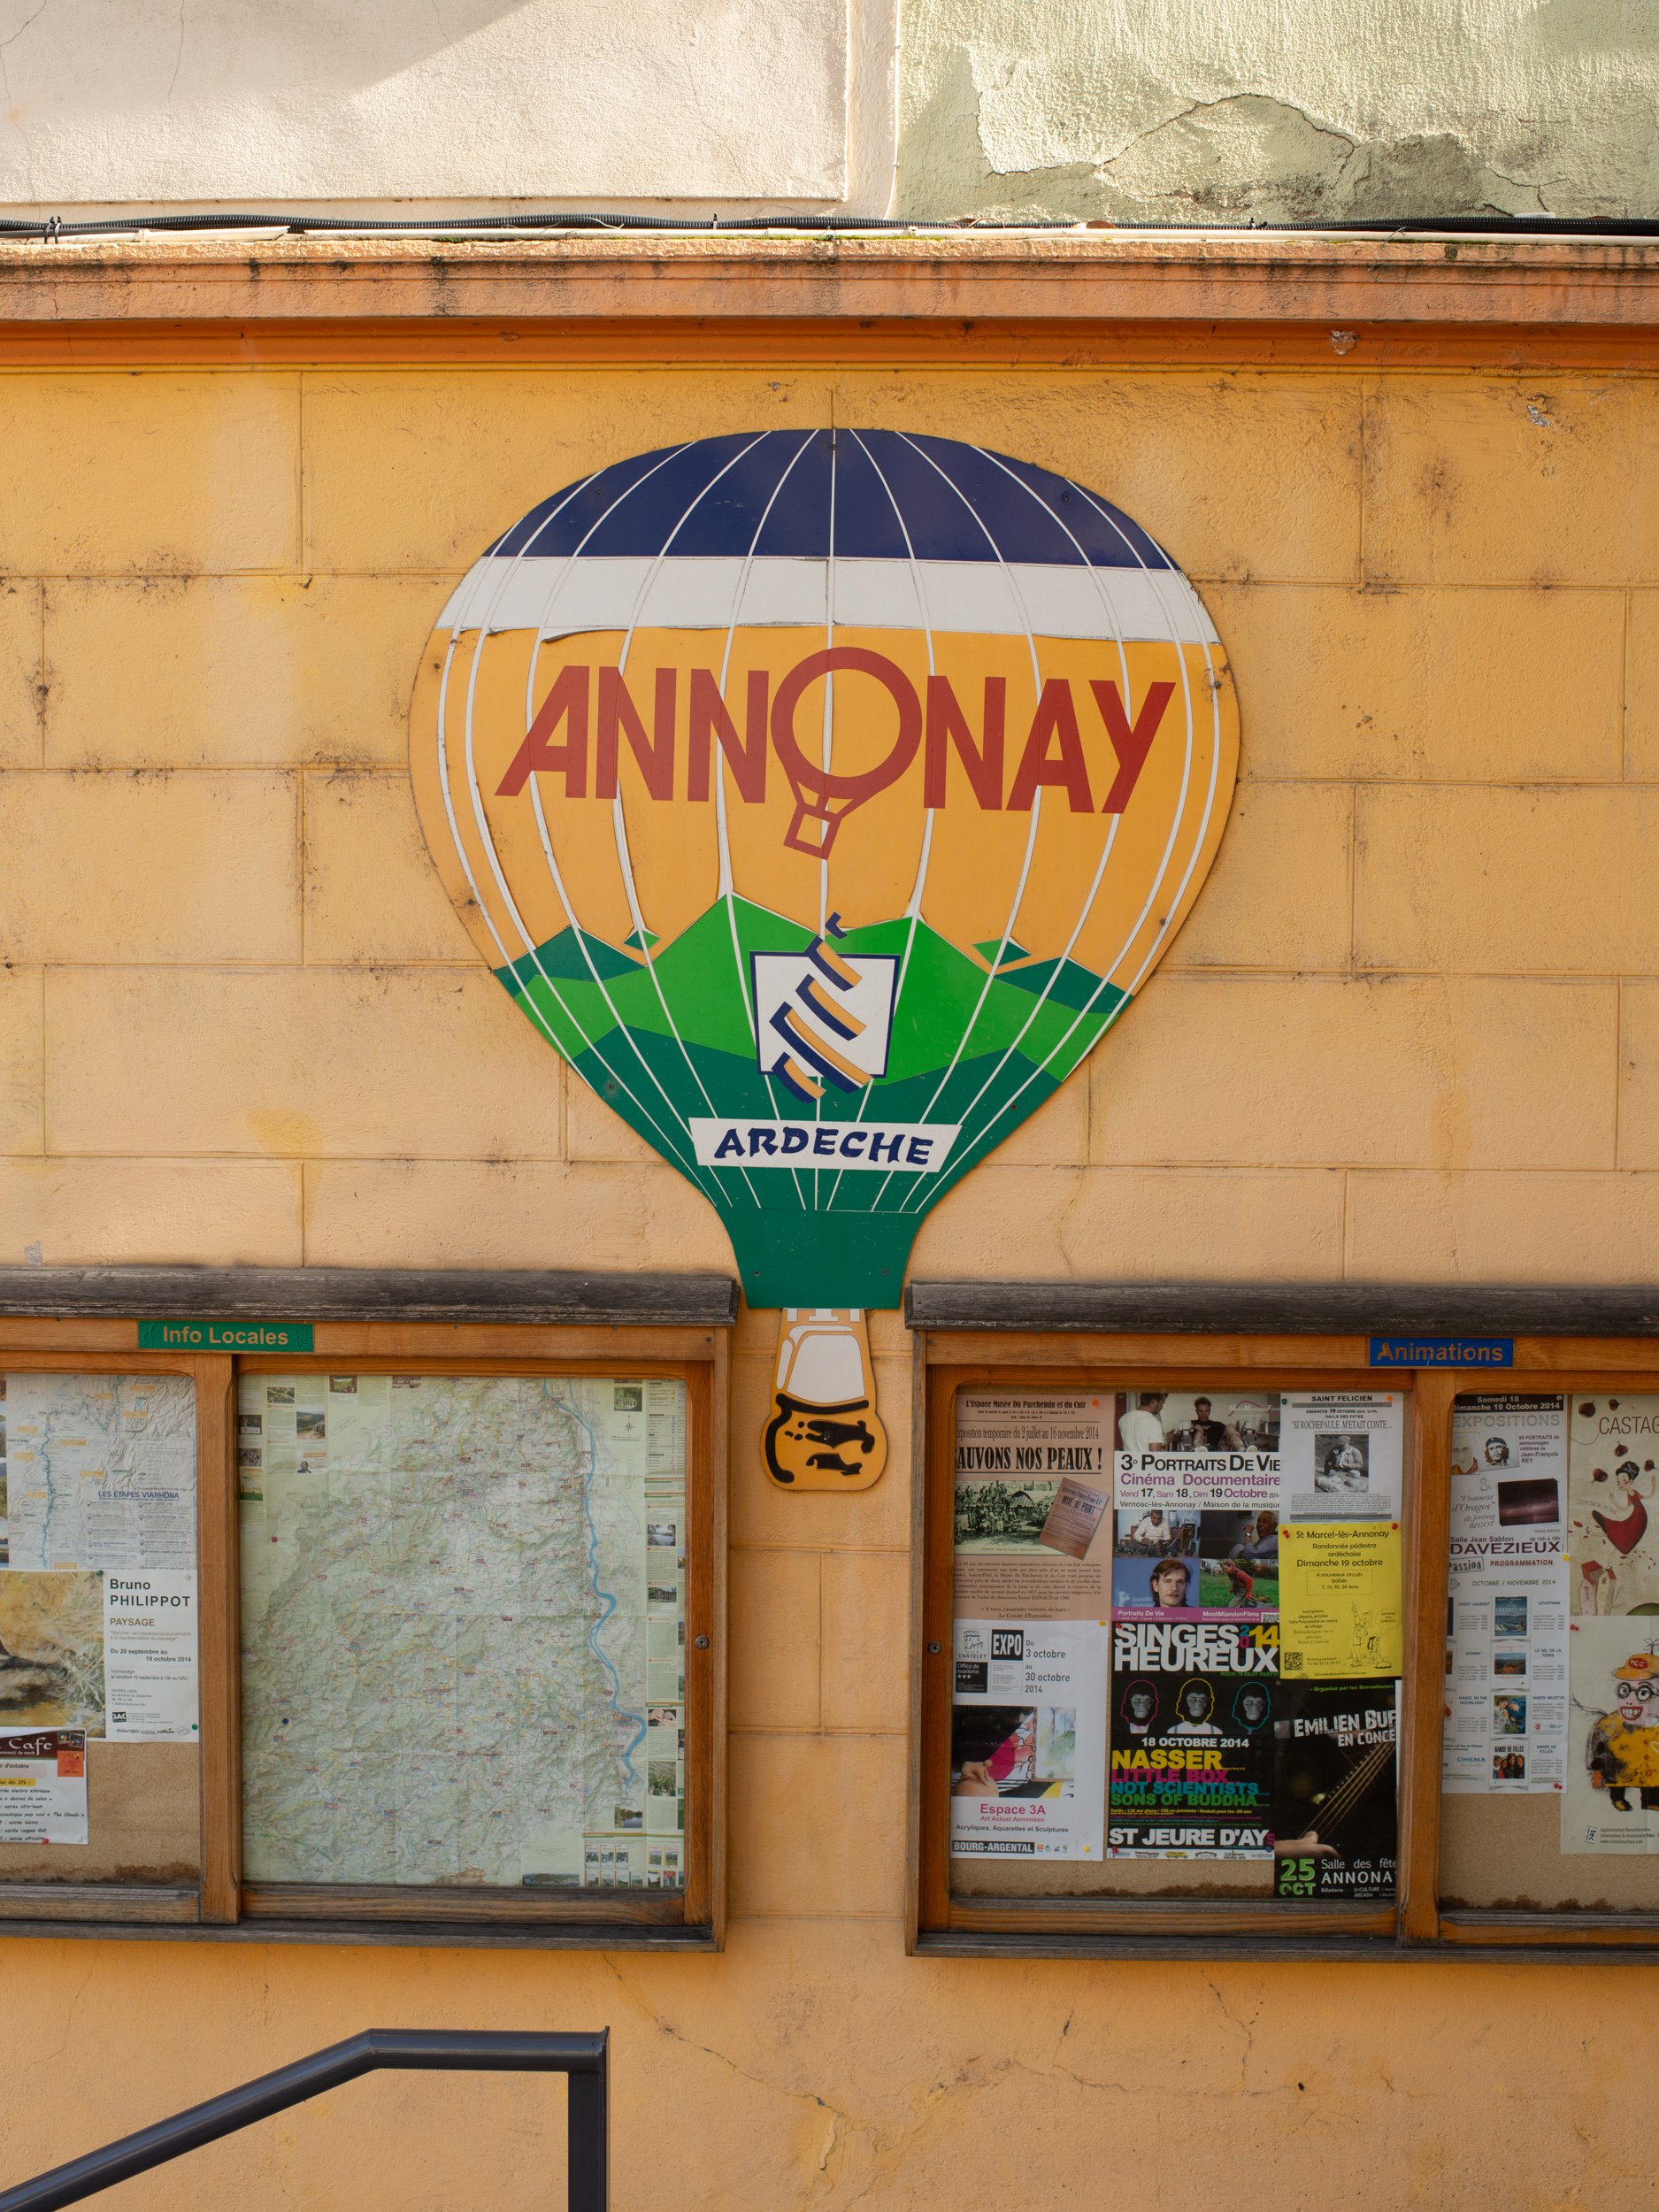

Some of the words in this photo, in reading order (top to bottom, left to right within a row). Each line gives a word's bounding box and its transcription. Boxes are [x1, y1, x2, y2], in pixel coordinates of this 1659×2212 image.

[494, 647, 1177, 818] ANNONAY
[714, 1126, 933, 1165] ARDECHE
[163, 1325, 203, 1343] Info
[209, 1326, 289, 1345] Locales
[1376, 1341, 1504, 1362] Animations
[965, 1400, 992, 1409] L'Espace
[993, 1400, 1011, 1409] Musée
[1453, 1414, 1561, 1428] EXPOSITIONS
[983, 1426, 1012, 1440] temporaire
[1013, 1426, 1021, 1440] du
[1021, 1426, 1025, 1440] 2
[1025, 1425, 1041, 1441] juillet
[1042, 1429, 1049, 1440] au
[1050, 1426, 1057, 1440] 16
[1057, 1426, 1085, 1440] novembre
[1085, 1426, 1099, 1440] 2014
[956, 1447, 1011, 1470] AUVONS
[1016, 1447, 1042, 1470] NOS
[1047, 1447, 1093, 1471] PEAUX
[1141, 1454, 1226, 1471] PORTRAITS
[1120, 1472, 1175, 1486] Cinéma
[1182, 1473, 1280, 1486] Documentaire
[1479, 1478, 1492, 1492] &
[113, 1489, 141, 1498] ÉTAPES
[1210, 1488, 1223, 1498] 19
[1224, 1488, 1268, 1498] Octobre
[1120, 1501, 1196, 1509] Vernosc-lès-Annonay
[1307, 1530, 1390, 1539] Marcel-lès-Annonay
[1451, 1541, 1560, 1555] DAVEZIEUX
[1449, 1560, 1482, 1572] assion
[110, 1578, 150, 1590] Bruno
[110, 1594, 191, 1607] PHILIPPOT
[110, 1617, 155, 1626] PAYSAGE
[1114, 1622, 1239, 1648] SINGES
[993, 1633, 1022, 1656] EXPO
[1025, 1648, 1032, 1658] 3
[1033, 1649, 1066, 1659] octobre
[1114, 1647, 1279, 1672] HEUREUX
[1025, 1672, 1035, 1681] 30
[1037, 1673, 1071, 1682] octobre
[1294, 1713, 1360, 1738] EMILIEN
[1141, 1737, 1156, 1747] 18
[1159, 1737, 1217, 1747] OCTOBRE
[1220, 1738, 1249, 1748] 2014
[1337, 1733, 1354, 1747] EN
[1357, 1729, 1396, 1746] CONCE
[1111, 1749, 1223, 1770] NASSER
[1111, 1769, 1180, 1783] LITTLE
[1187, 1769, 1228, 1784] BOX
[1110, 1781, 1148, 1795] NOT
[1153, 1781, 1259, 1795] SCIENTISTS
[1110, 1793, 1156, 1806] SONS
[1161, 1793, 1183, 1806] OF
[1188, 1793, 1257, 1807] BUDDHA
[979, 1803, 1025, 1816] Espace
[1029, 1804, 1046, 1815] 3A
[1109, 1827, 1139, 1846] ST
[1141, 1828, 1216, 1846] JEURE
[1219, 1829, 1270, 1847] D'AY
[954, 1841, 1033, 1853] BOURG-ARGENTAL
[1280, 1857, 1316, 1881] 25
[1321, 1858, 1346, 1870] Salle
[1353, 1858, 1371, 1869] des
[1321, 1870, 1396, 1885] ANNONA
[1279, 1882, 1317, 1896] OCT
